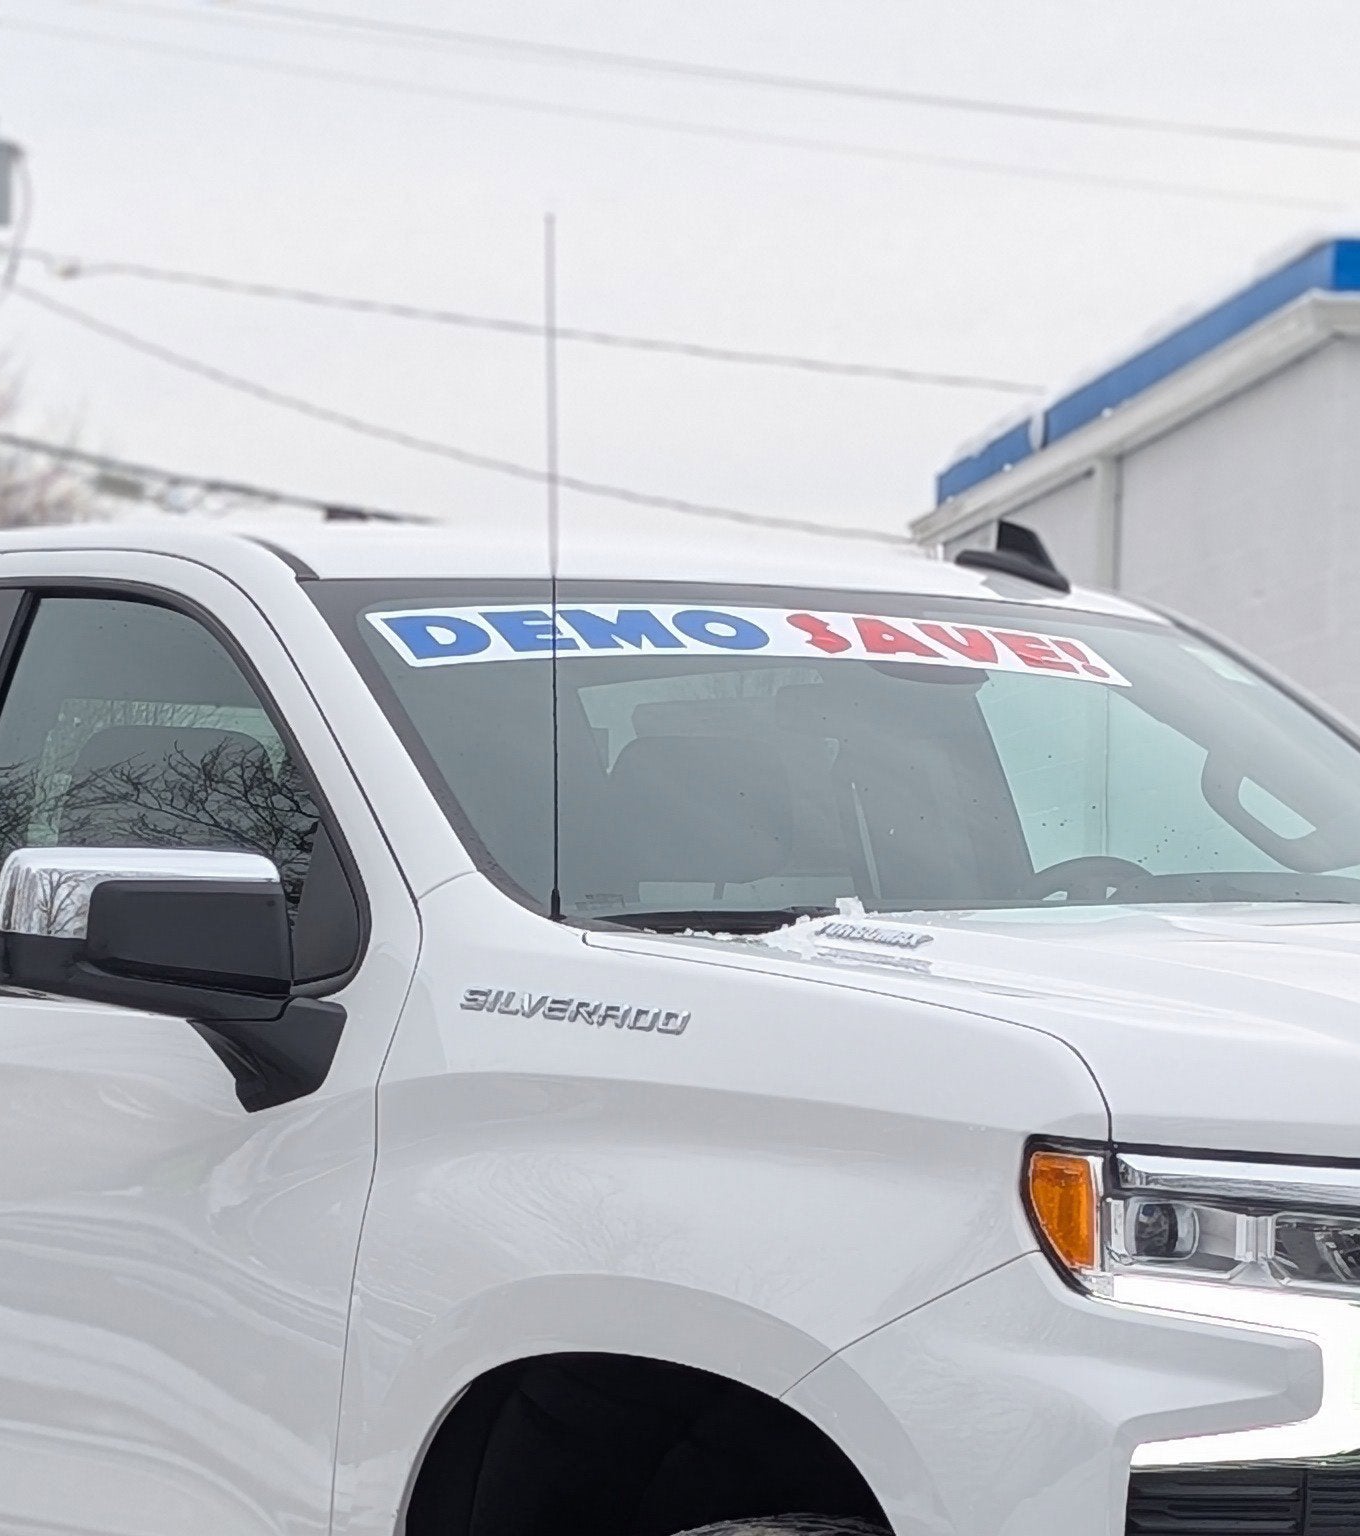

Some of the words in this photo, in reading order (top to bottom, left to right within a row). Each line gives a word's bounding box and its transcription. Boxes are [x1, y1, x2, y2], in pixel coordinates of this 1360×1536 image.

[380, 609, 770, 660] DEMO
[786, 613, 1110, 679] SAVE!
[460, 988, 691, 1036] SILVERADO
